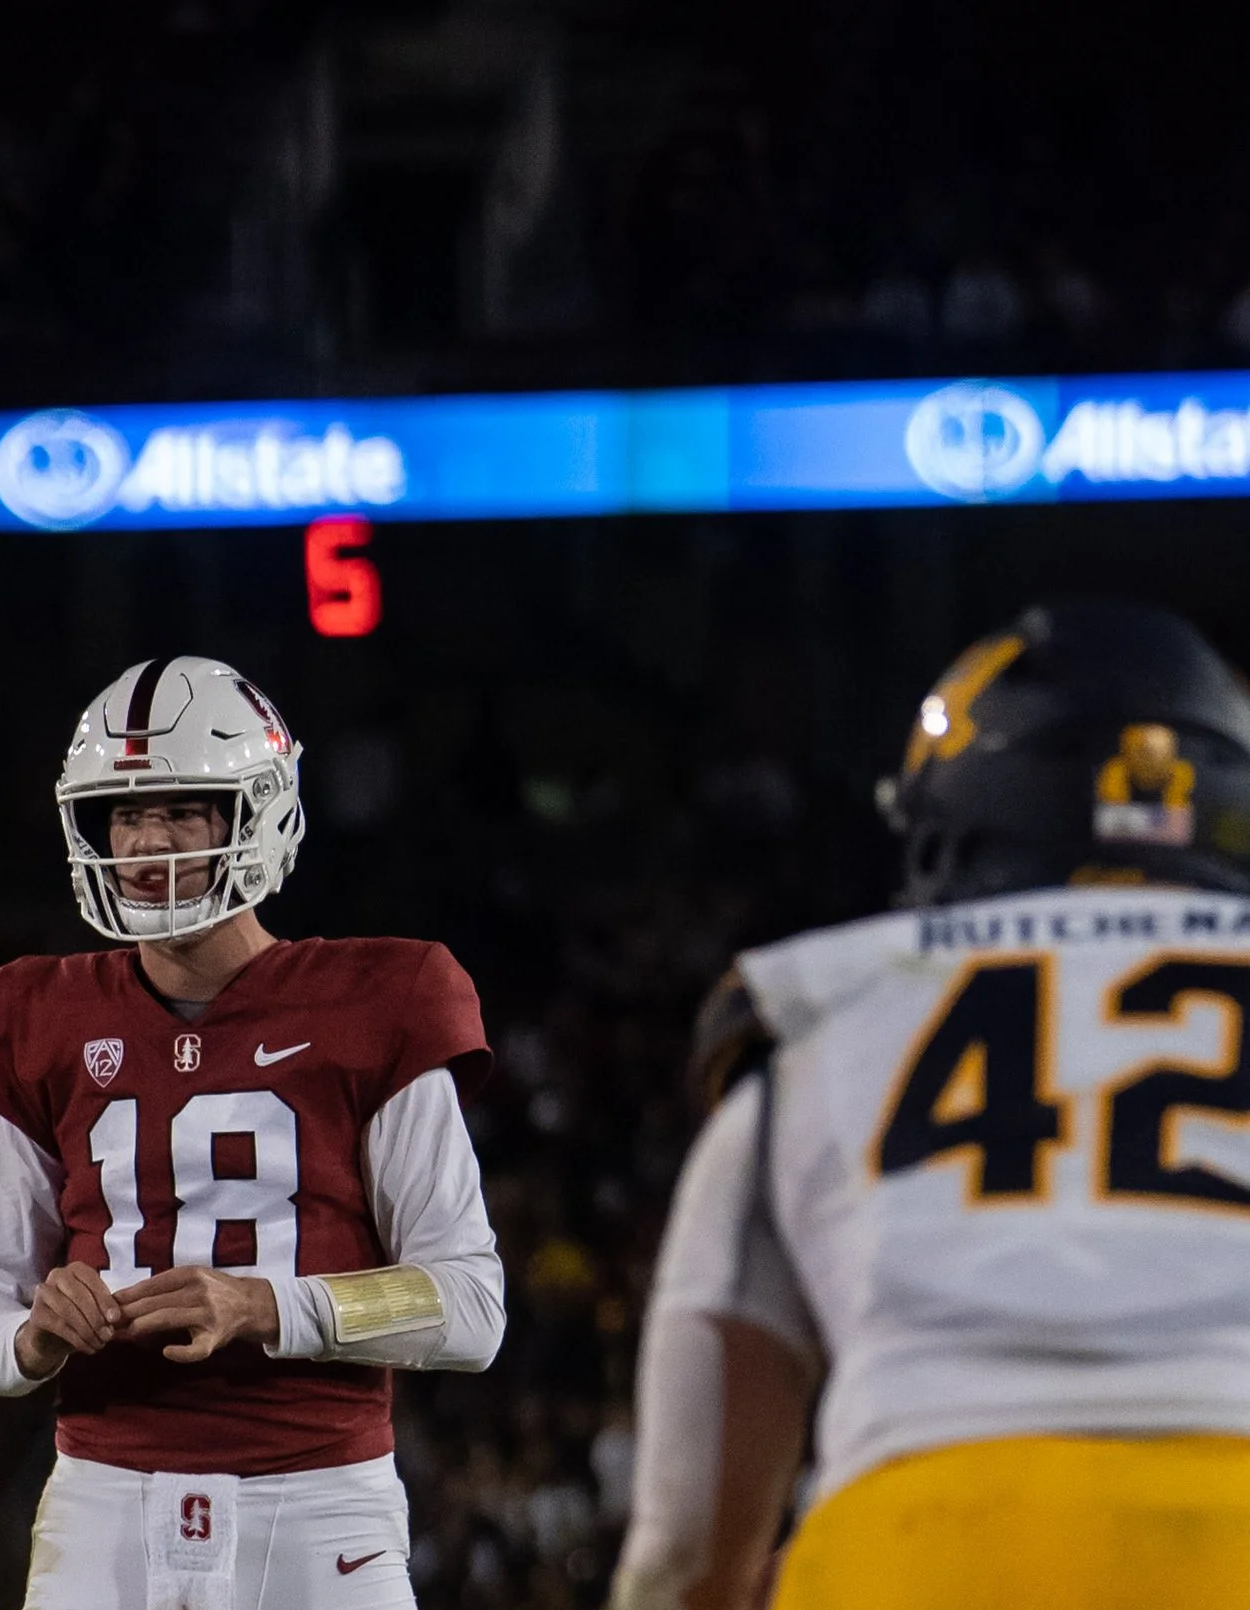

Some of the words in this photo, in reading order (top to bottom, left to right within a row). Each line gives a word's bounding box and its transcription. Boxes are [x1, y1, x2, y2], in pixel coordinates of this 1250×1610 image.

[115, 424, 406, 512] Allstate
[1043, 397, 1250, 483] Allsta
[86, 1040, 121, 1069] PAC
[95, 1059, 112, 1077] 12
[868, 951, 1250, 1212] 42
[89, 1091, 297, 1297] 18
